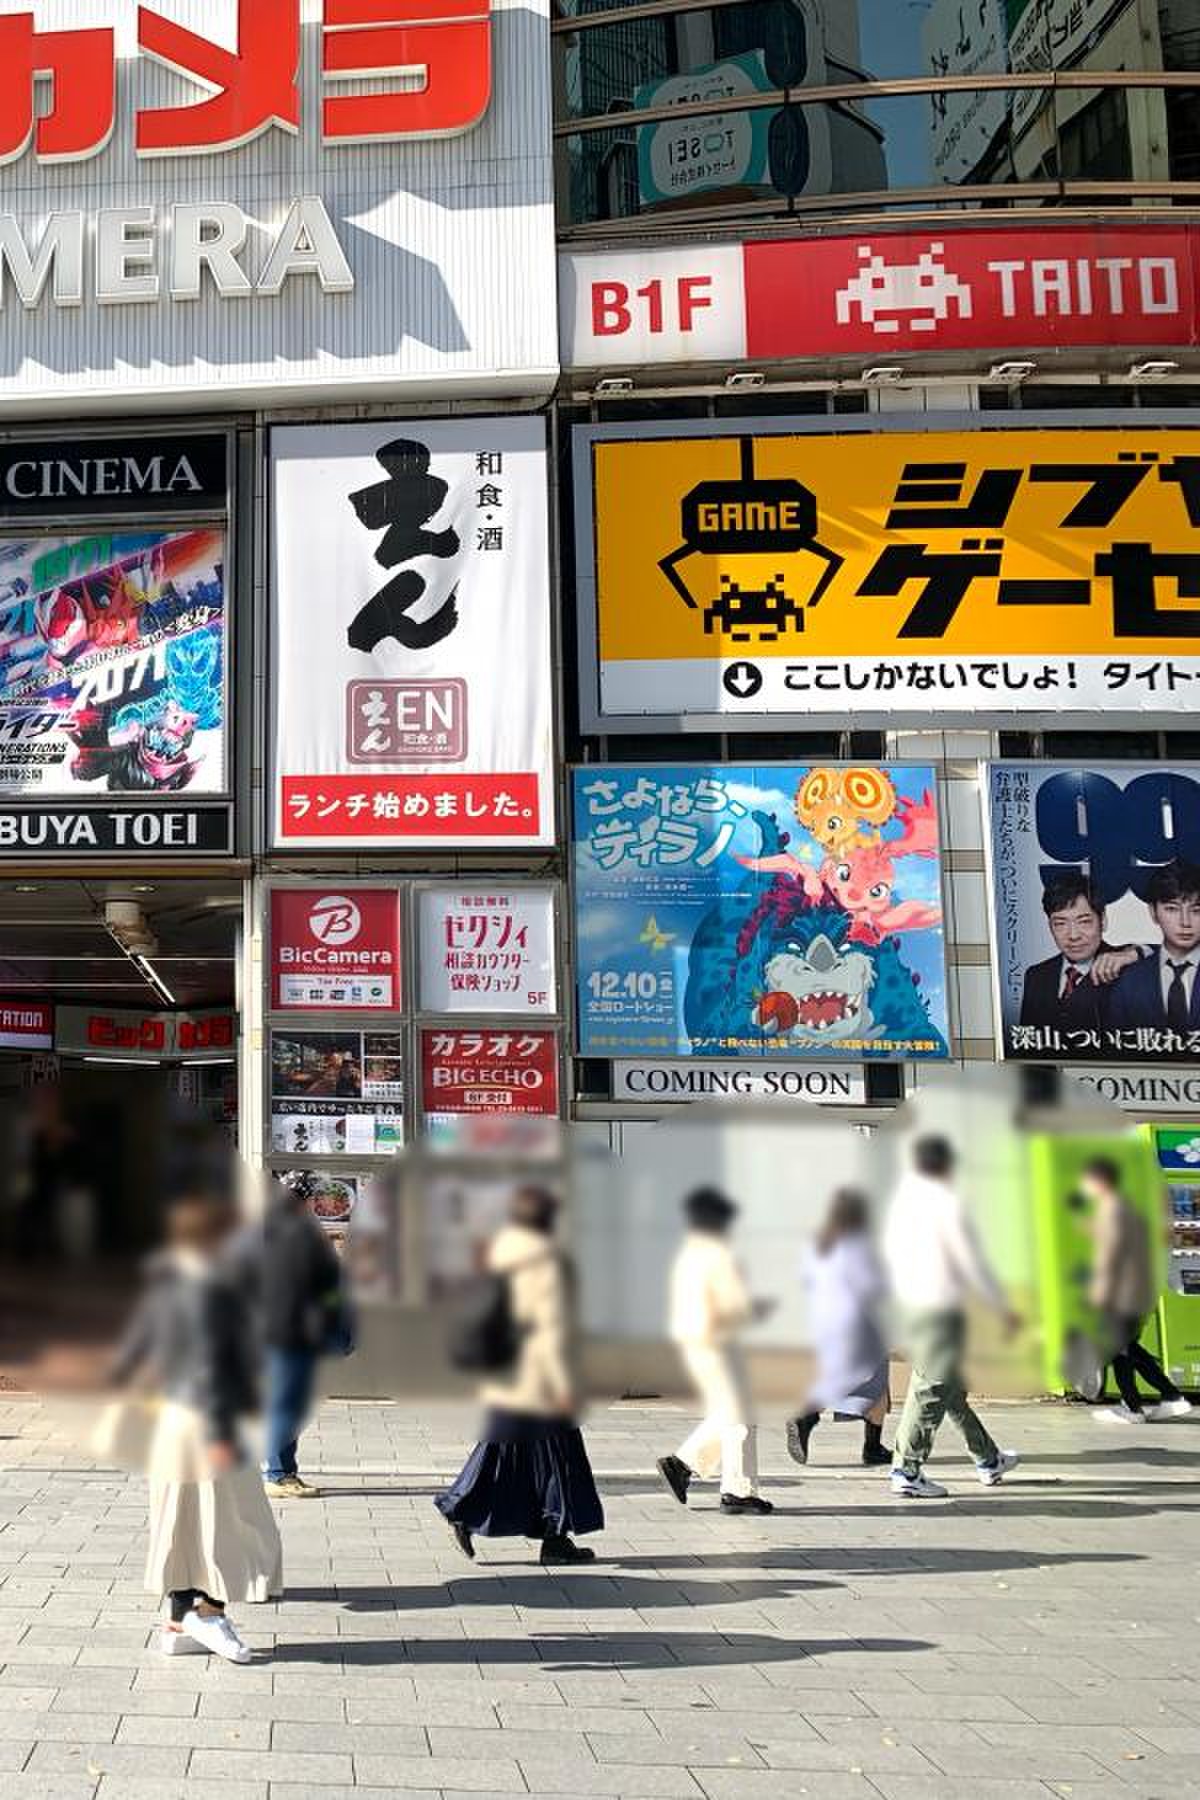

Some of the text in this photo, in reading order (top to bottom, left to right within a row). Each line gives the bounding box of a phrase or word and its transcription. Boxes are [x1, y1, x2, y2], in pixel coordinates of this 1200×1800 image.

[988, 258, 1179, 317] TAITO
[591, 276, 712, 337] B1F
[6, 456, 202, 498] CINEMA
[475, 450, 504, 551] 和食・酒
[347, 439, 461, 653] えん
[783, 662, 1200, 690] ここしかないでしょ! タイト
[397, 689, 453, 731] EN
[288, 792, 533, 819] ランチ始めました。
[108, 814, 198, 845] TOEI
[280, 947, 392, 964] BicCamera
[528, 991, 546, 1005] 5F
[431, 1034, 544, 1057] カラオケ
[433, 1067, 543, 1089] BIG ECHO
[626, 1070, 851, 1095] COMING SOON
[1078, 1075, 1200, 1103] OMING
